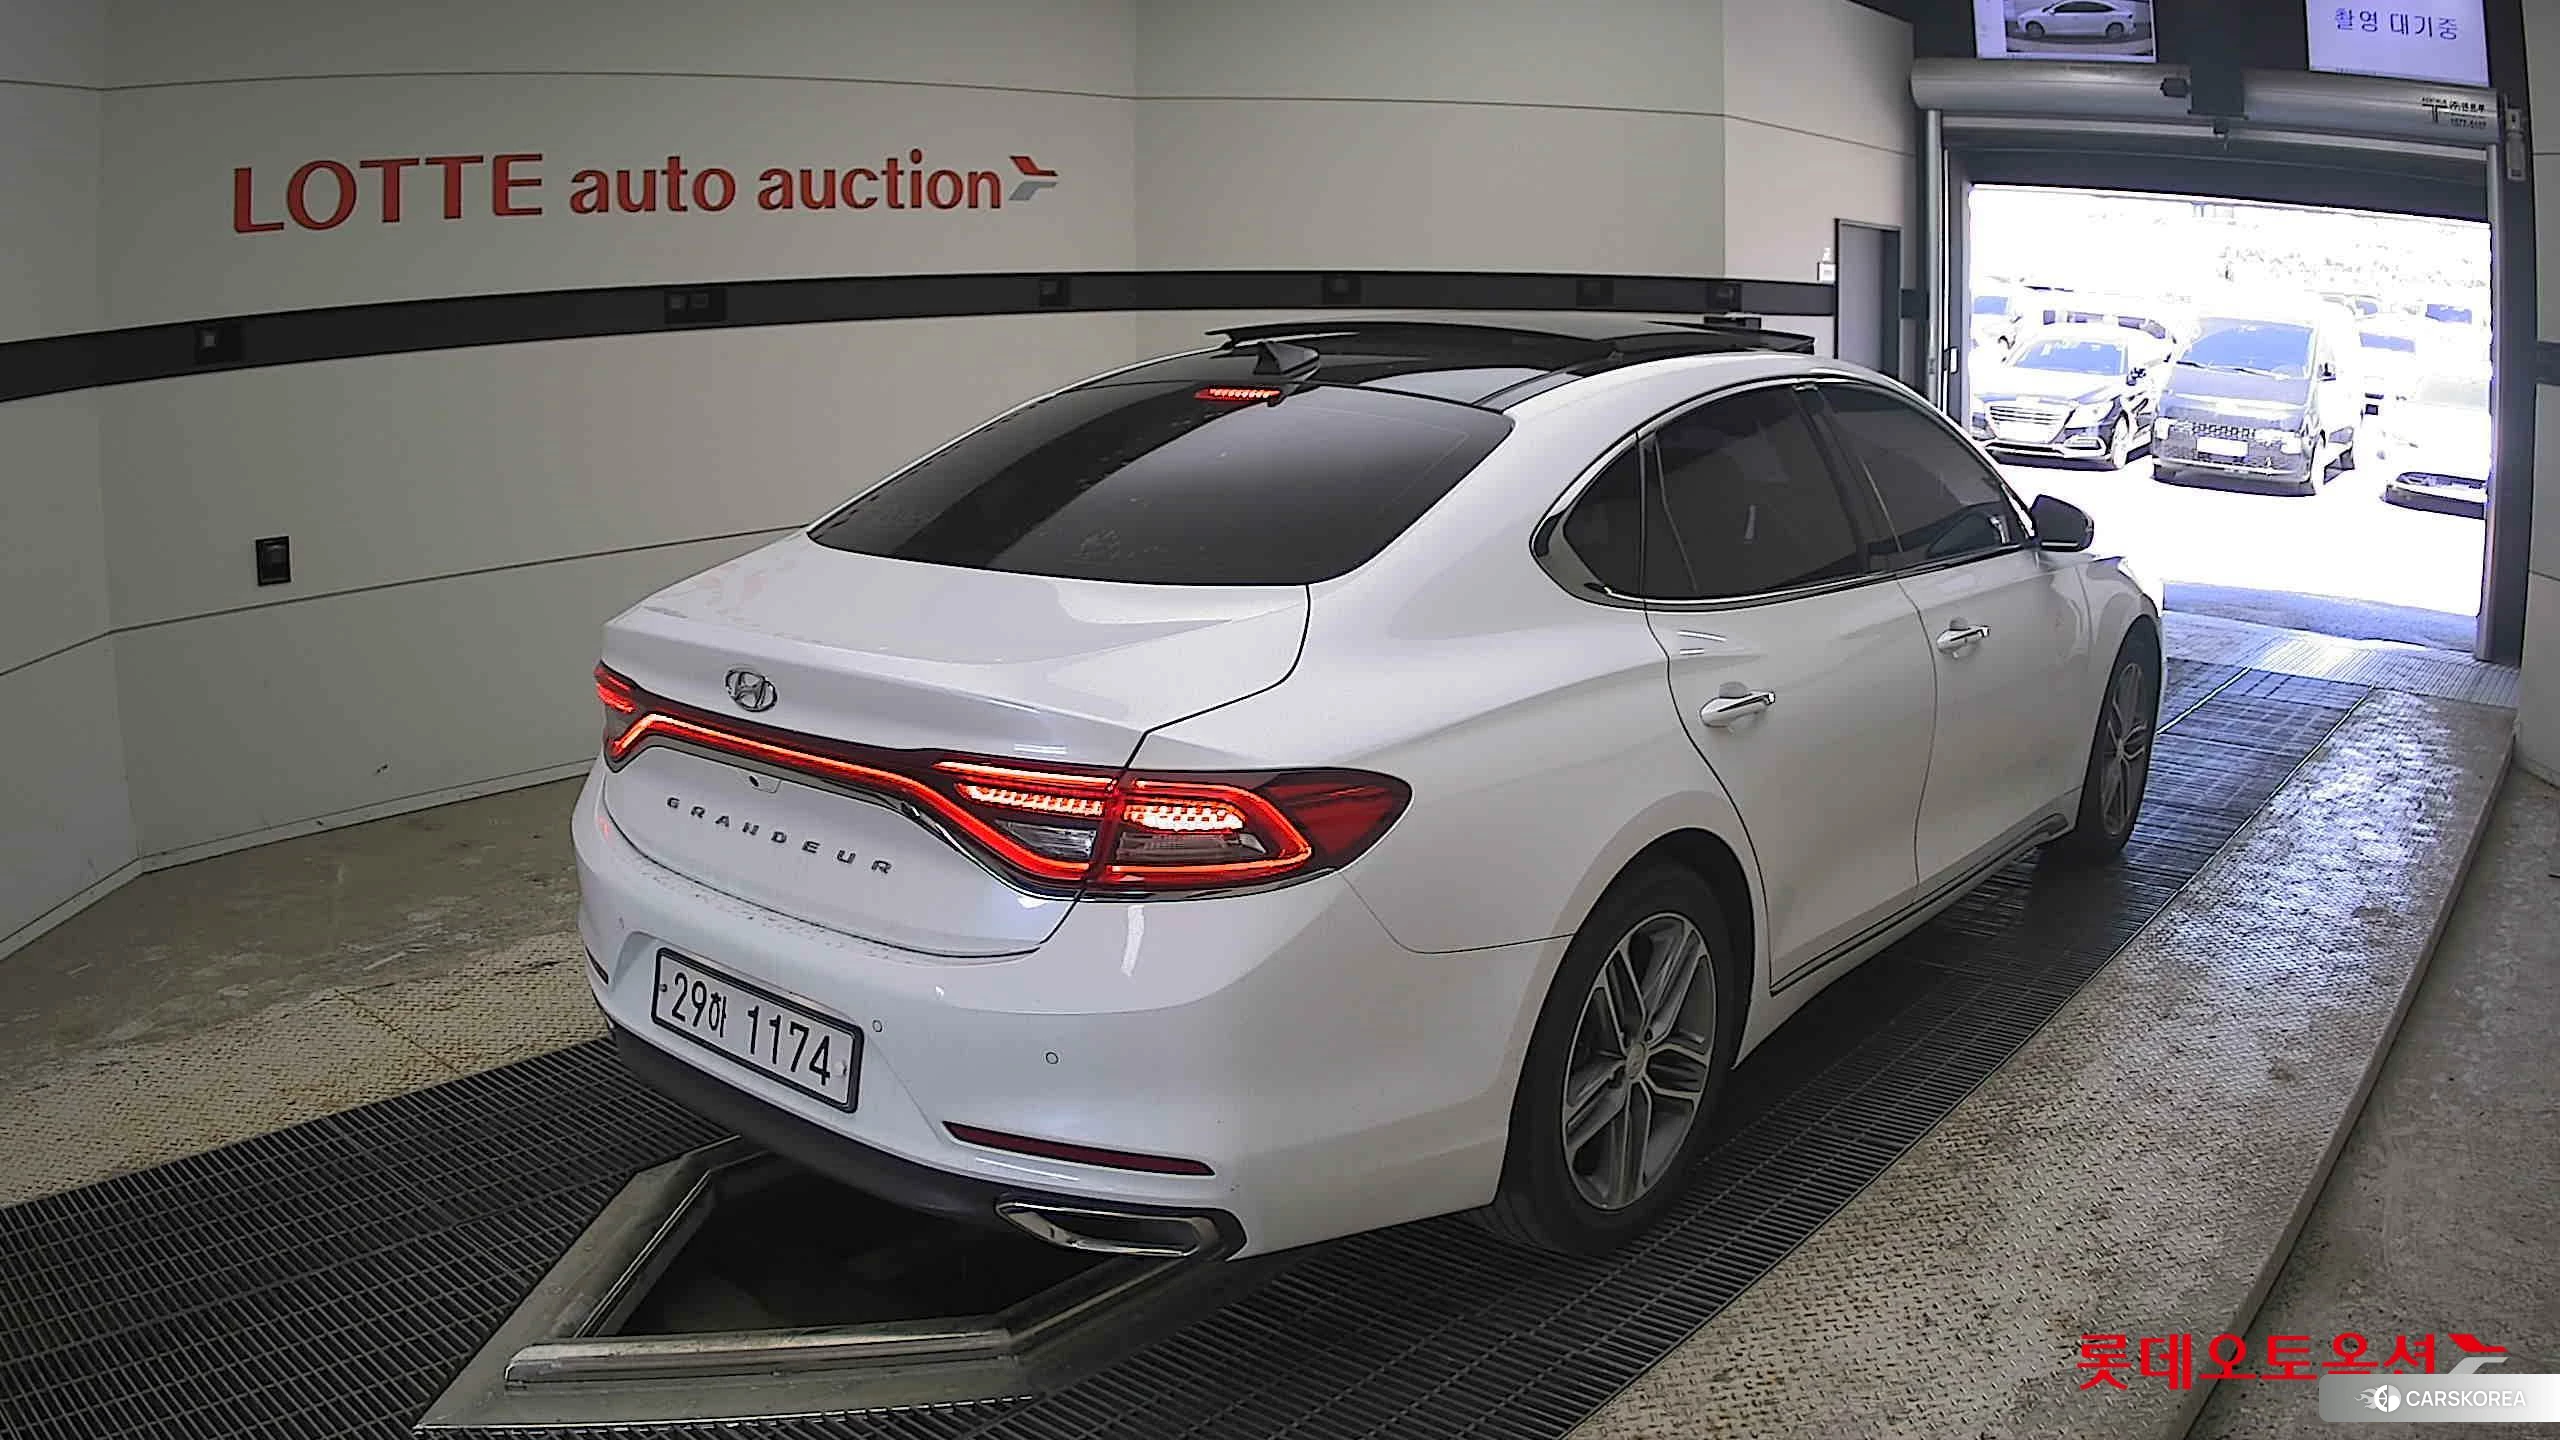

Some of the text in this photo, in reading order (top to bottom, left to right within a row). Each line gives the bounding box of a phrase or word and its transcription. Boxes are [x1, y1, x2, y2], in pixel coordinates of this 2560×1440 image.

[2334, 7, 2458, 41] 촬영 대기중
[234, 148, 1002, 233] LOTTE auto auction
[666, 796, 893, 875] GRANDEUR
[671, 971, 831, 1087] 29하 1174
